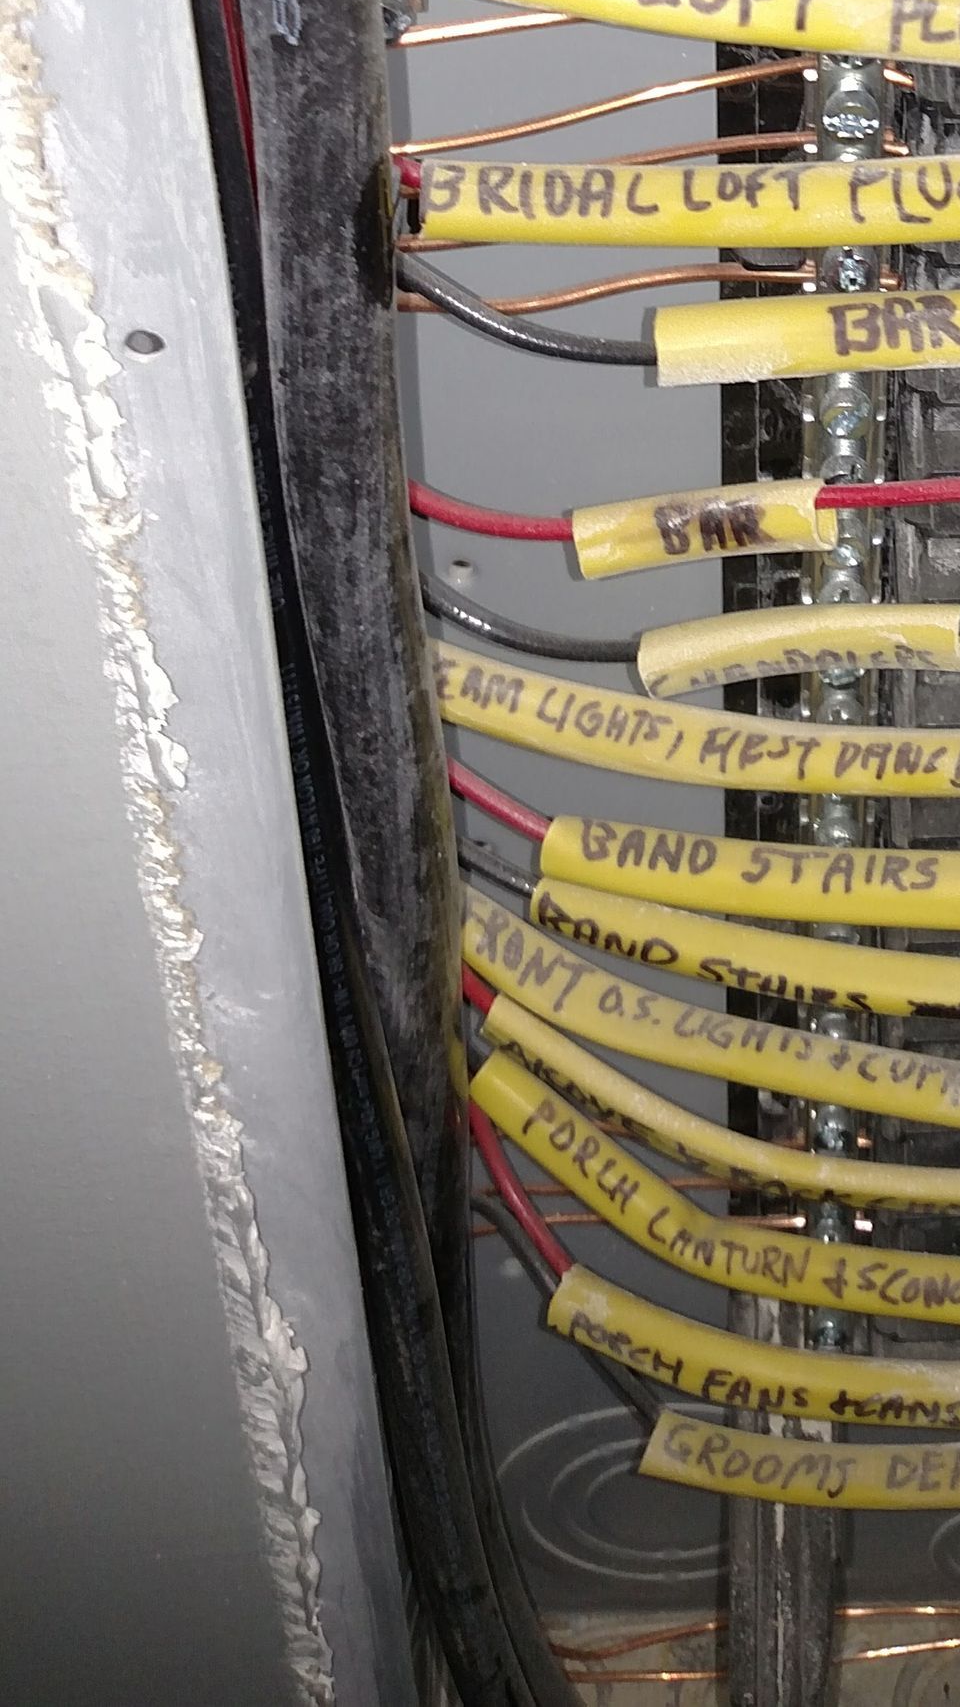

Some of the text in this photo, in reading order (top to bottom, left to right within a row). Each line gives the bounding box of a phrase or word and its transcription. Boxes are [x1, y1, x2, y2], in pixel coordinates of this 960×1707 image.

[423, 164, 659, 220] BRIDAL
[684, 167, 802, 212] LOFT
[655, 500, 767, 555] BAR
[580, 818, 717, 875] BAND
[740, 845, 939, 895] STAIRS
[536, 890, 679, 966] BAND
[520, 1097, 641, 1217] PORCH
[568, 1310, 684, 1387] PORCH
[702, 1369, 809, 1412] FANS
[663, 1422, 857, 1499] GROOMS
